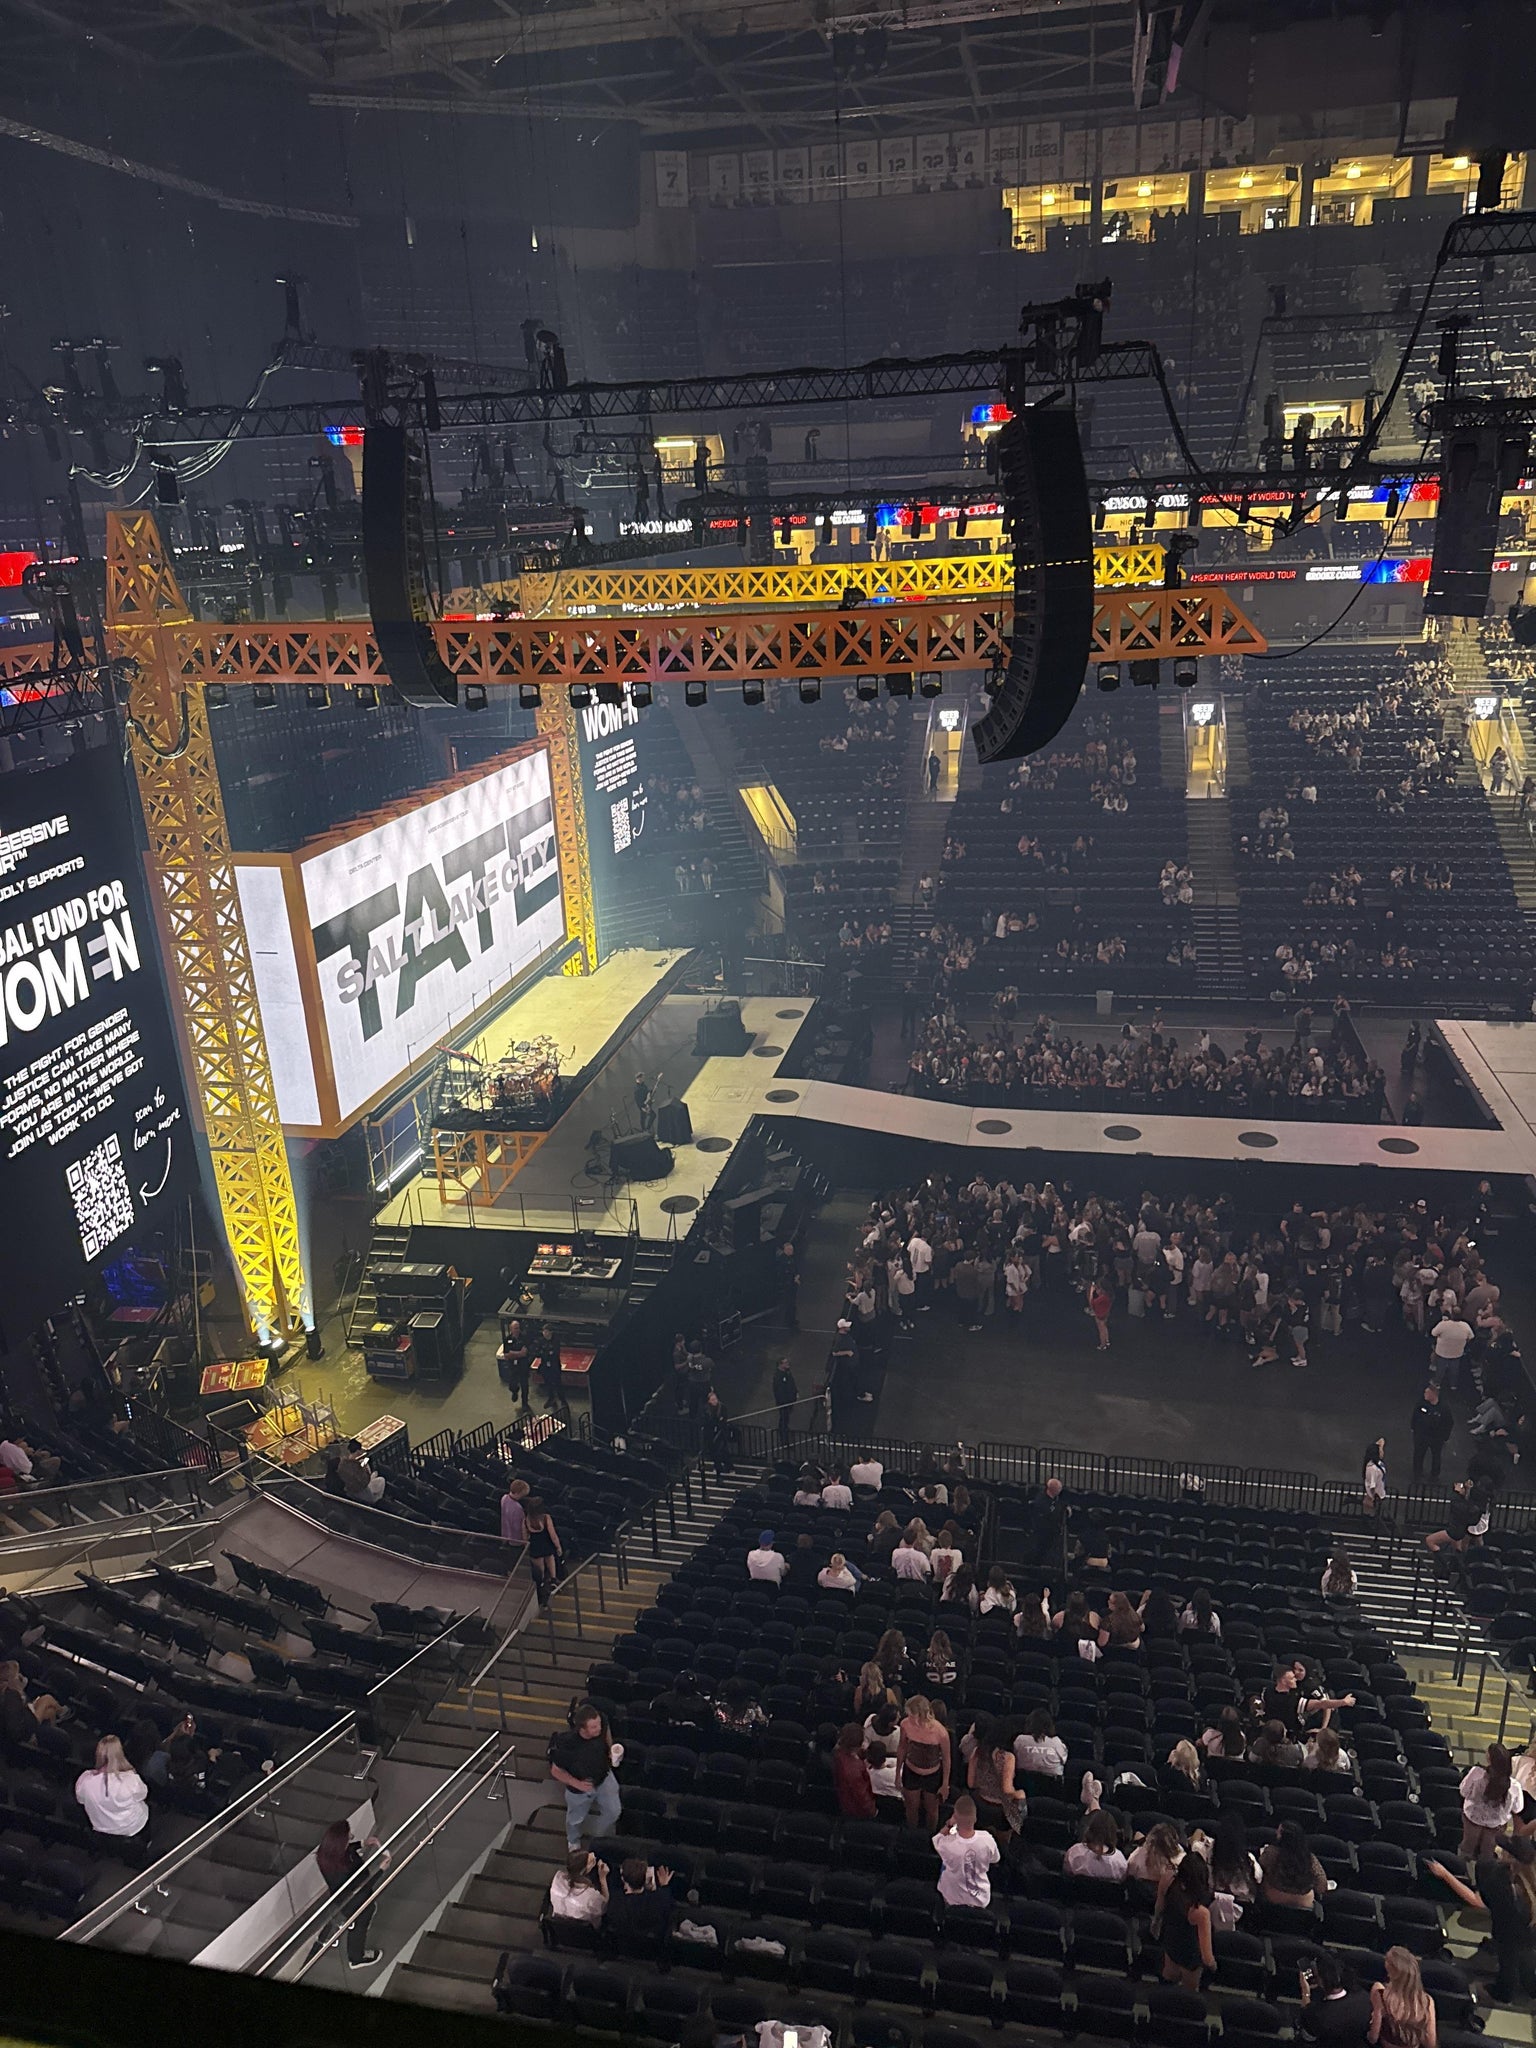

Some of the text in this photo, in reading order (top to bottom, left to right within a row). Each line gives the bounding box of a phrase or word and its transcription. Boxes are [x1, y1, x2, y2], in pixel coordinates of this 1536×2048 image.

[1190, 570, 1297, 582] AMERICAN HEART WORLD TOUR
[27, 856, 85, 889] SUPPORTS
[32, 898, 89, 948] FUND
[87, 879, 129, 922] FOR
[312, 796, 560, 1043] TATE
[337, 835, 552, 1005] SALT LAKE CITY
[0, 1030, 141, 1130] FORMS, NO MATTER WHERE
[2, 1019, 133, 1111] JUSTICE CAN TAKE MANY
[3, 1007, 129, 1090] THE FIGHT FOR GENDER
[8, 1129, 36, 1158] JOIN
[36, 1120, 54, 1139] US
[124, 1056, 145, 1078] GOT
[13, 1049, 136, 1136] YOU ARE IN THE WORLD.
[48, 1094, 116, 1147] WORK TO DO.
[134, 1107, 181, 1151] learn more
[135, 1085, 166, 1123] scan to
[1024, 1745, 1057, 1756] TATE
